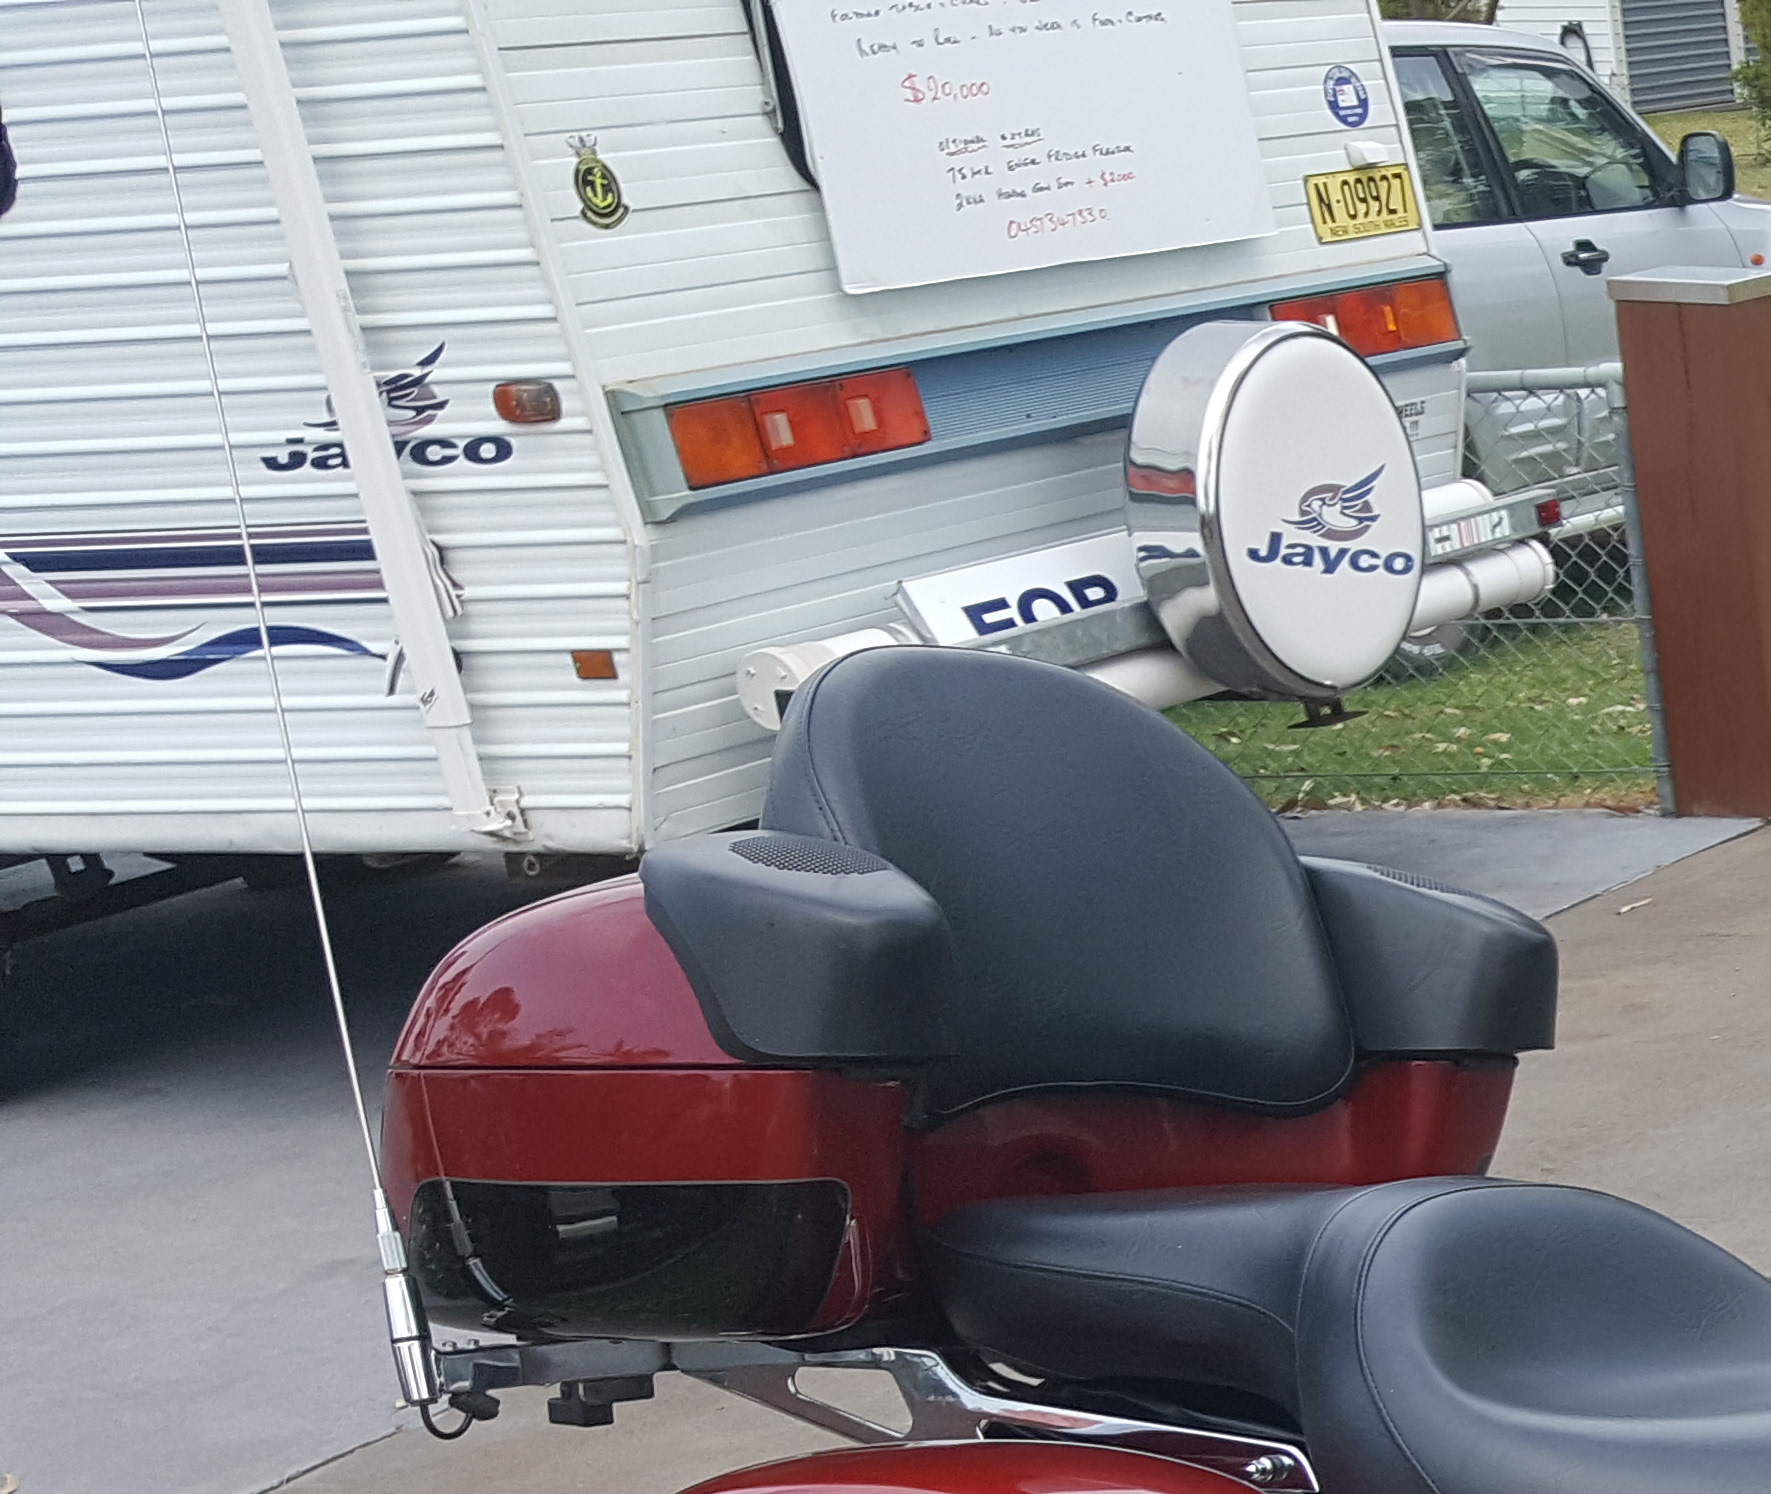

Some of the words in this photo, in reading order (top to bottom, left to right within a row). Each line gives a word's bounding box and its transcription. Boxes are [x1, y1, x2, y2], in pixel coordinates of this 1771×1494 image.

[901, 73, 990, 104] $20,000
[1330, 224, 1349, 238] NEW
[1353, 220, 1380, 234] SOUTH
[1383, 215, 1409, 229] WALES
[259, 436, 514, 472] Jaco
[1246, 531, 1415, 576] Jayco
